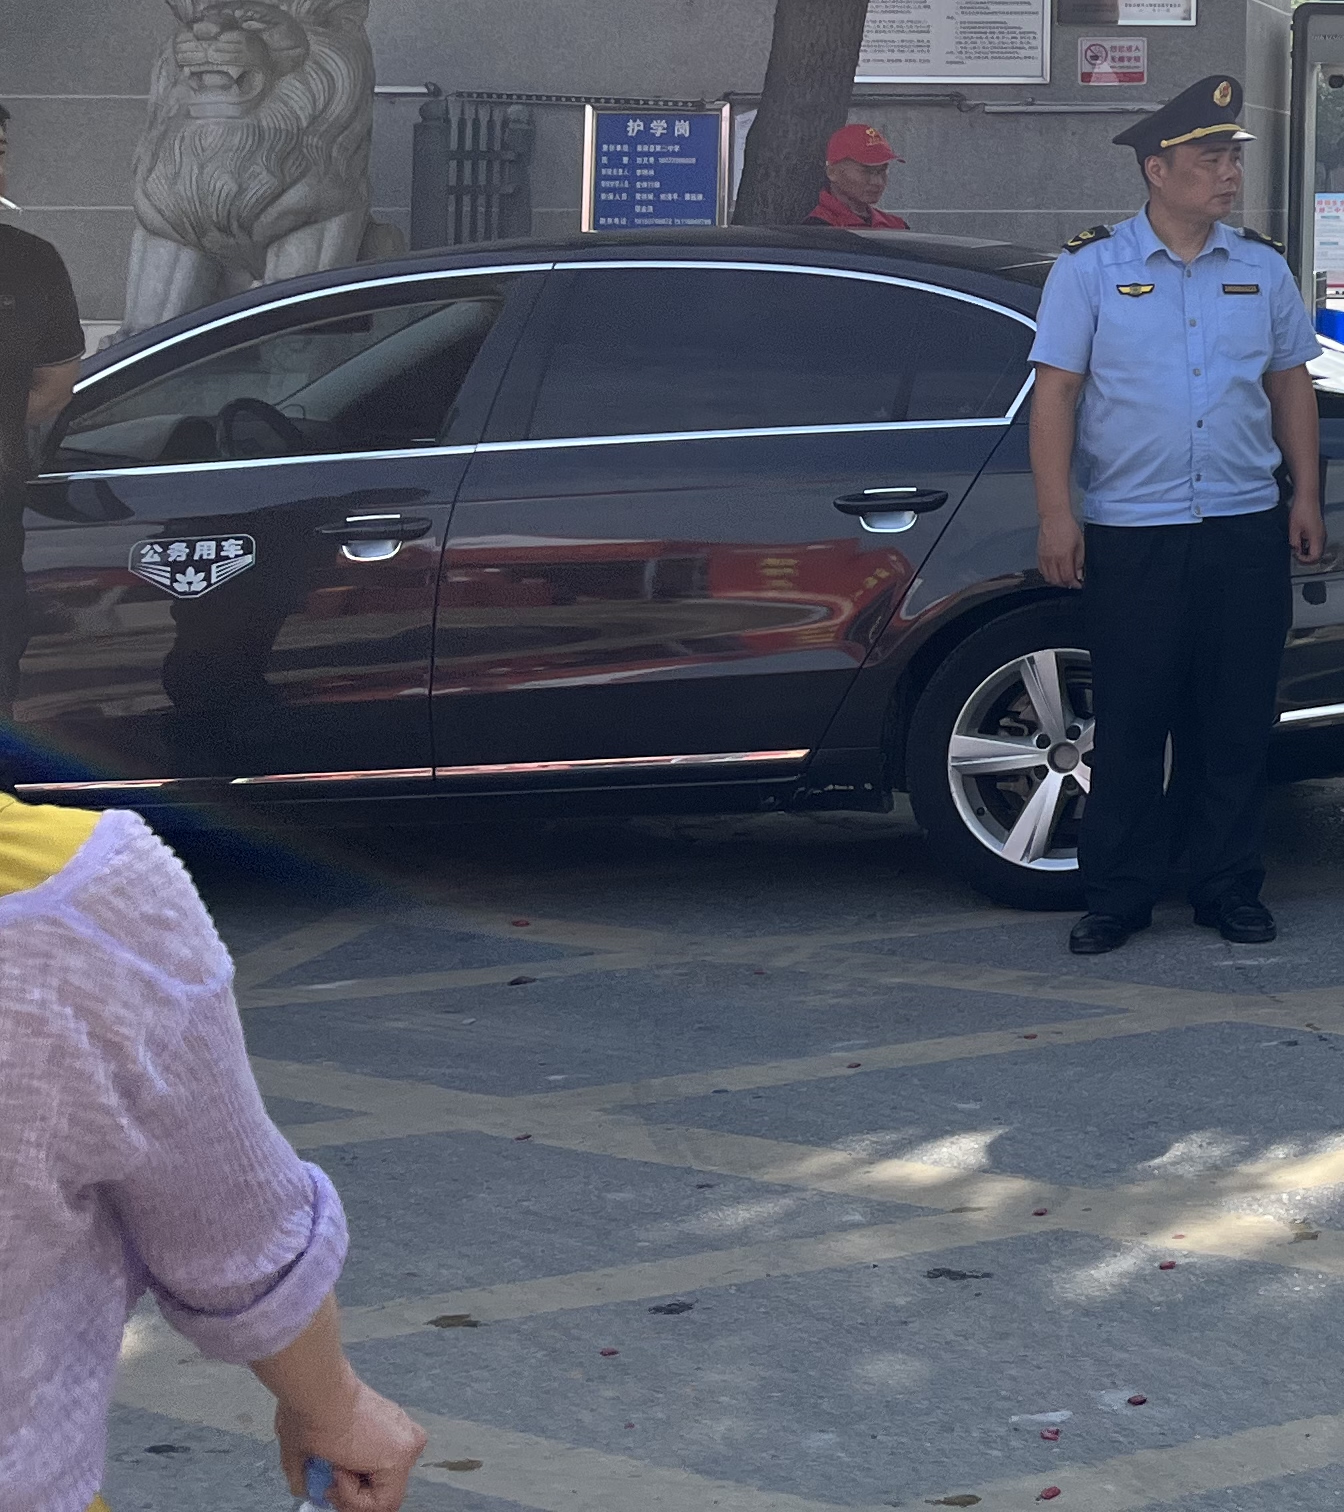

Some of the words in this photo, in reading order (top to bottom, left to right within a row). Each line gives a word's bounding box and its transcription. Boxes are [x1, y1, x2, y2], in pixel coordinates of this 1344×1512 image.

[626, 119, 690, 137] 护学岗
[140, 538, 244, 563] 公务用车
